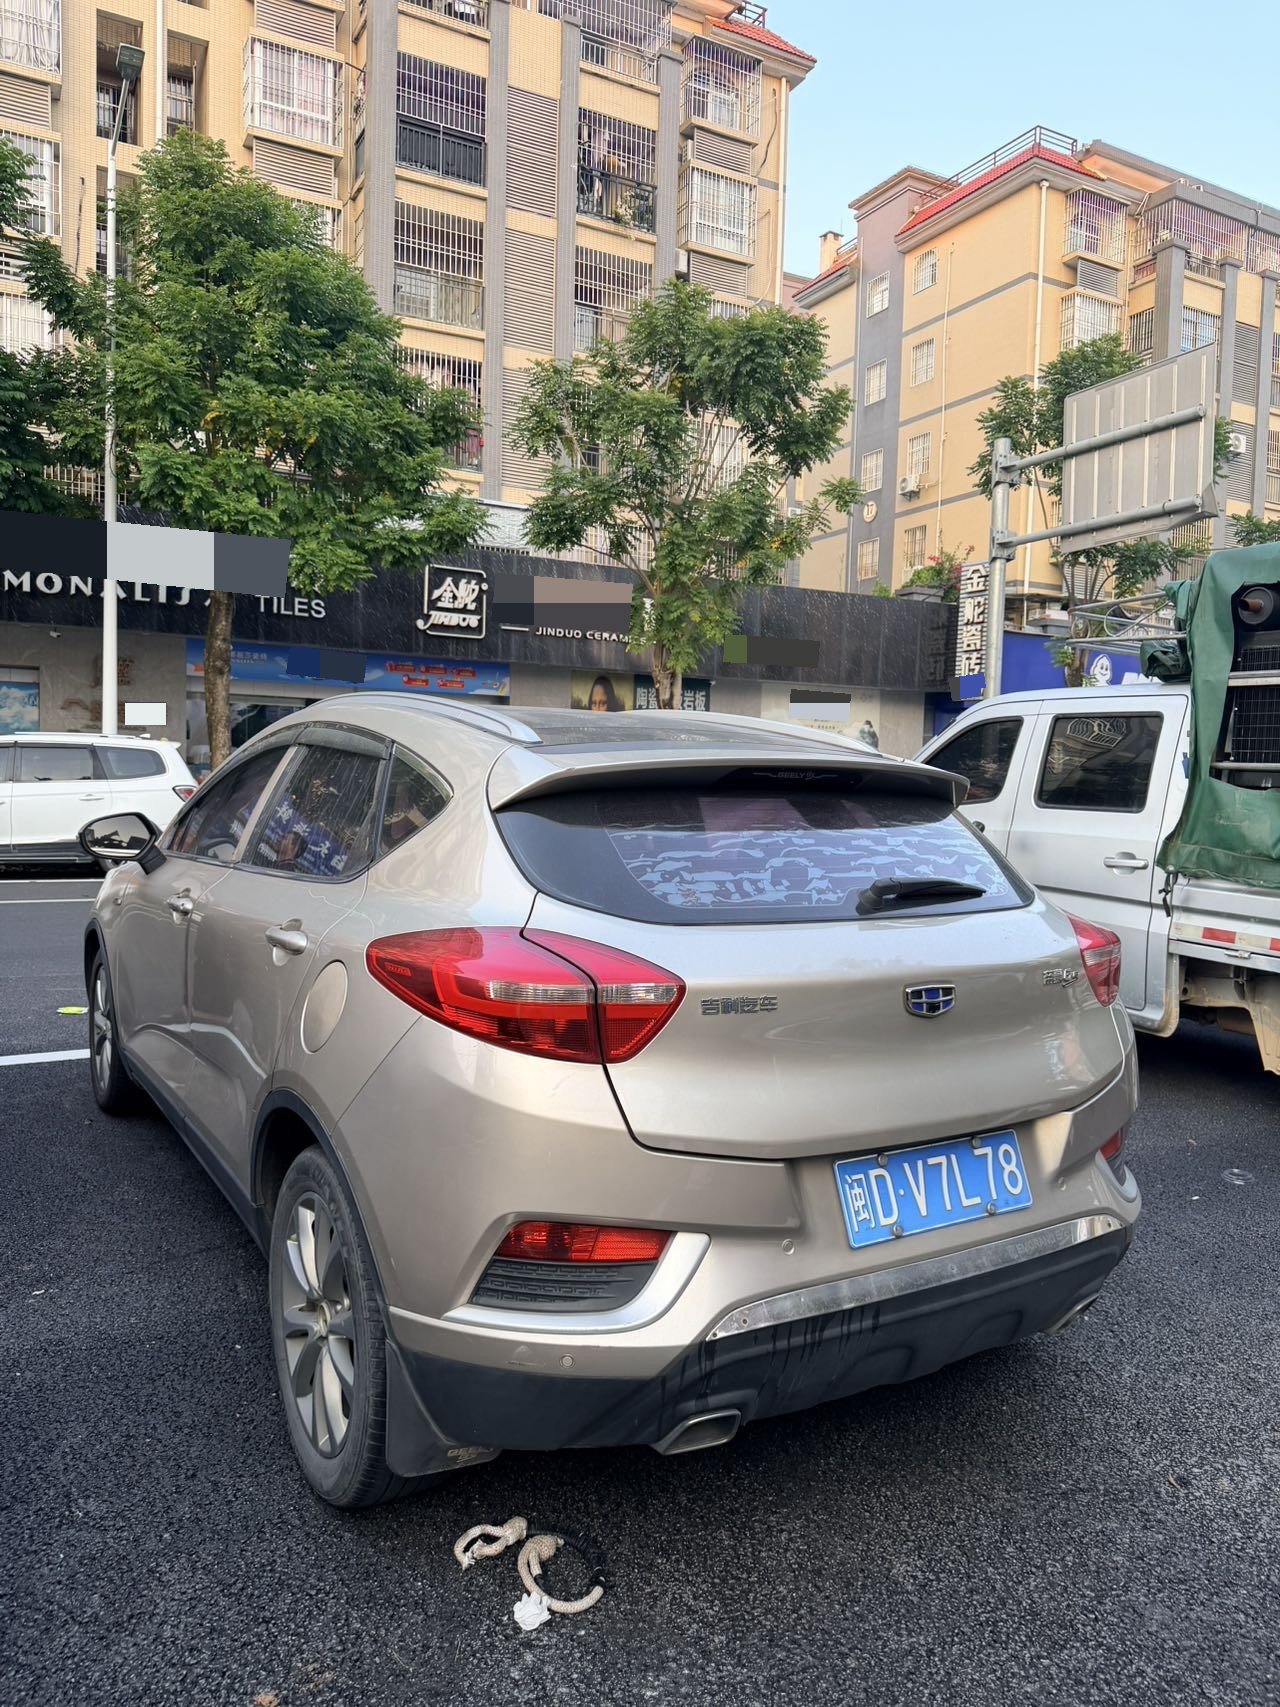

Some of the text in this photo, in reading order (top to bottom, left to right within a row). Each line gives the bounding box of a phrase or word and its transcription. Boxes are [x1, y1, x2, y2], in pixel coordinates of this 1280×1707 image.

[254, 594, 326, 619] TILES
[535, 626, 583, 639] JINDUO
[635, 687, 706, 712] 陶瓷岩板
[701, 995, 778, 1016] 吉利汽车
